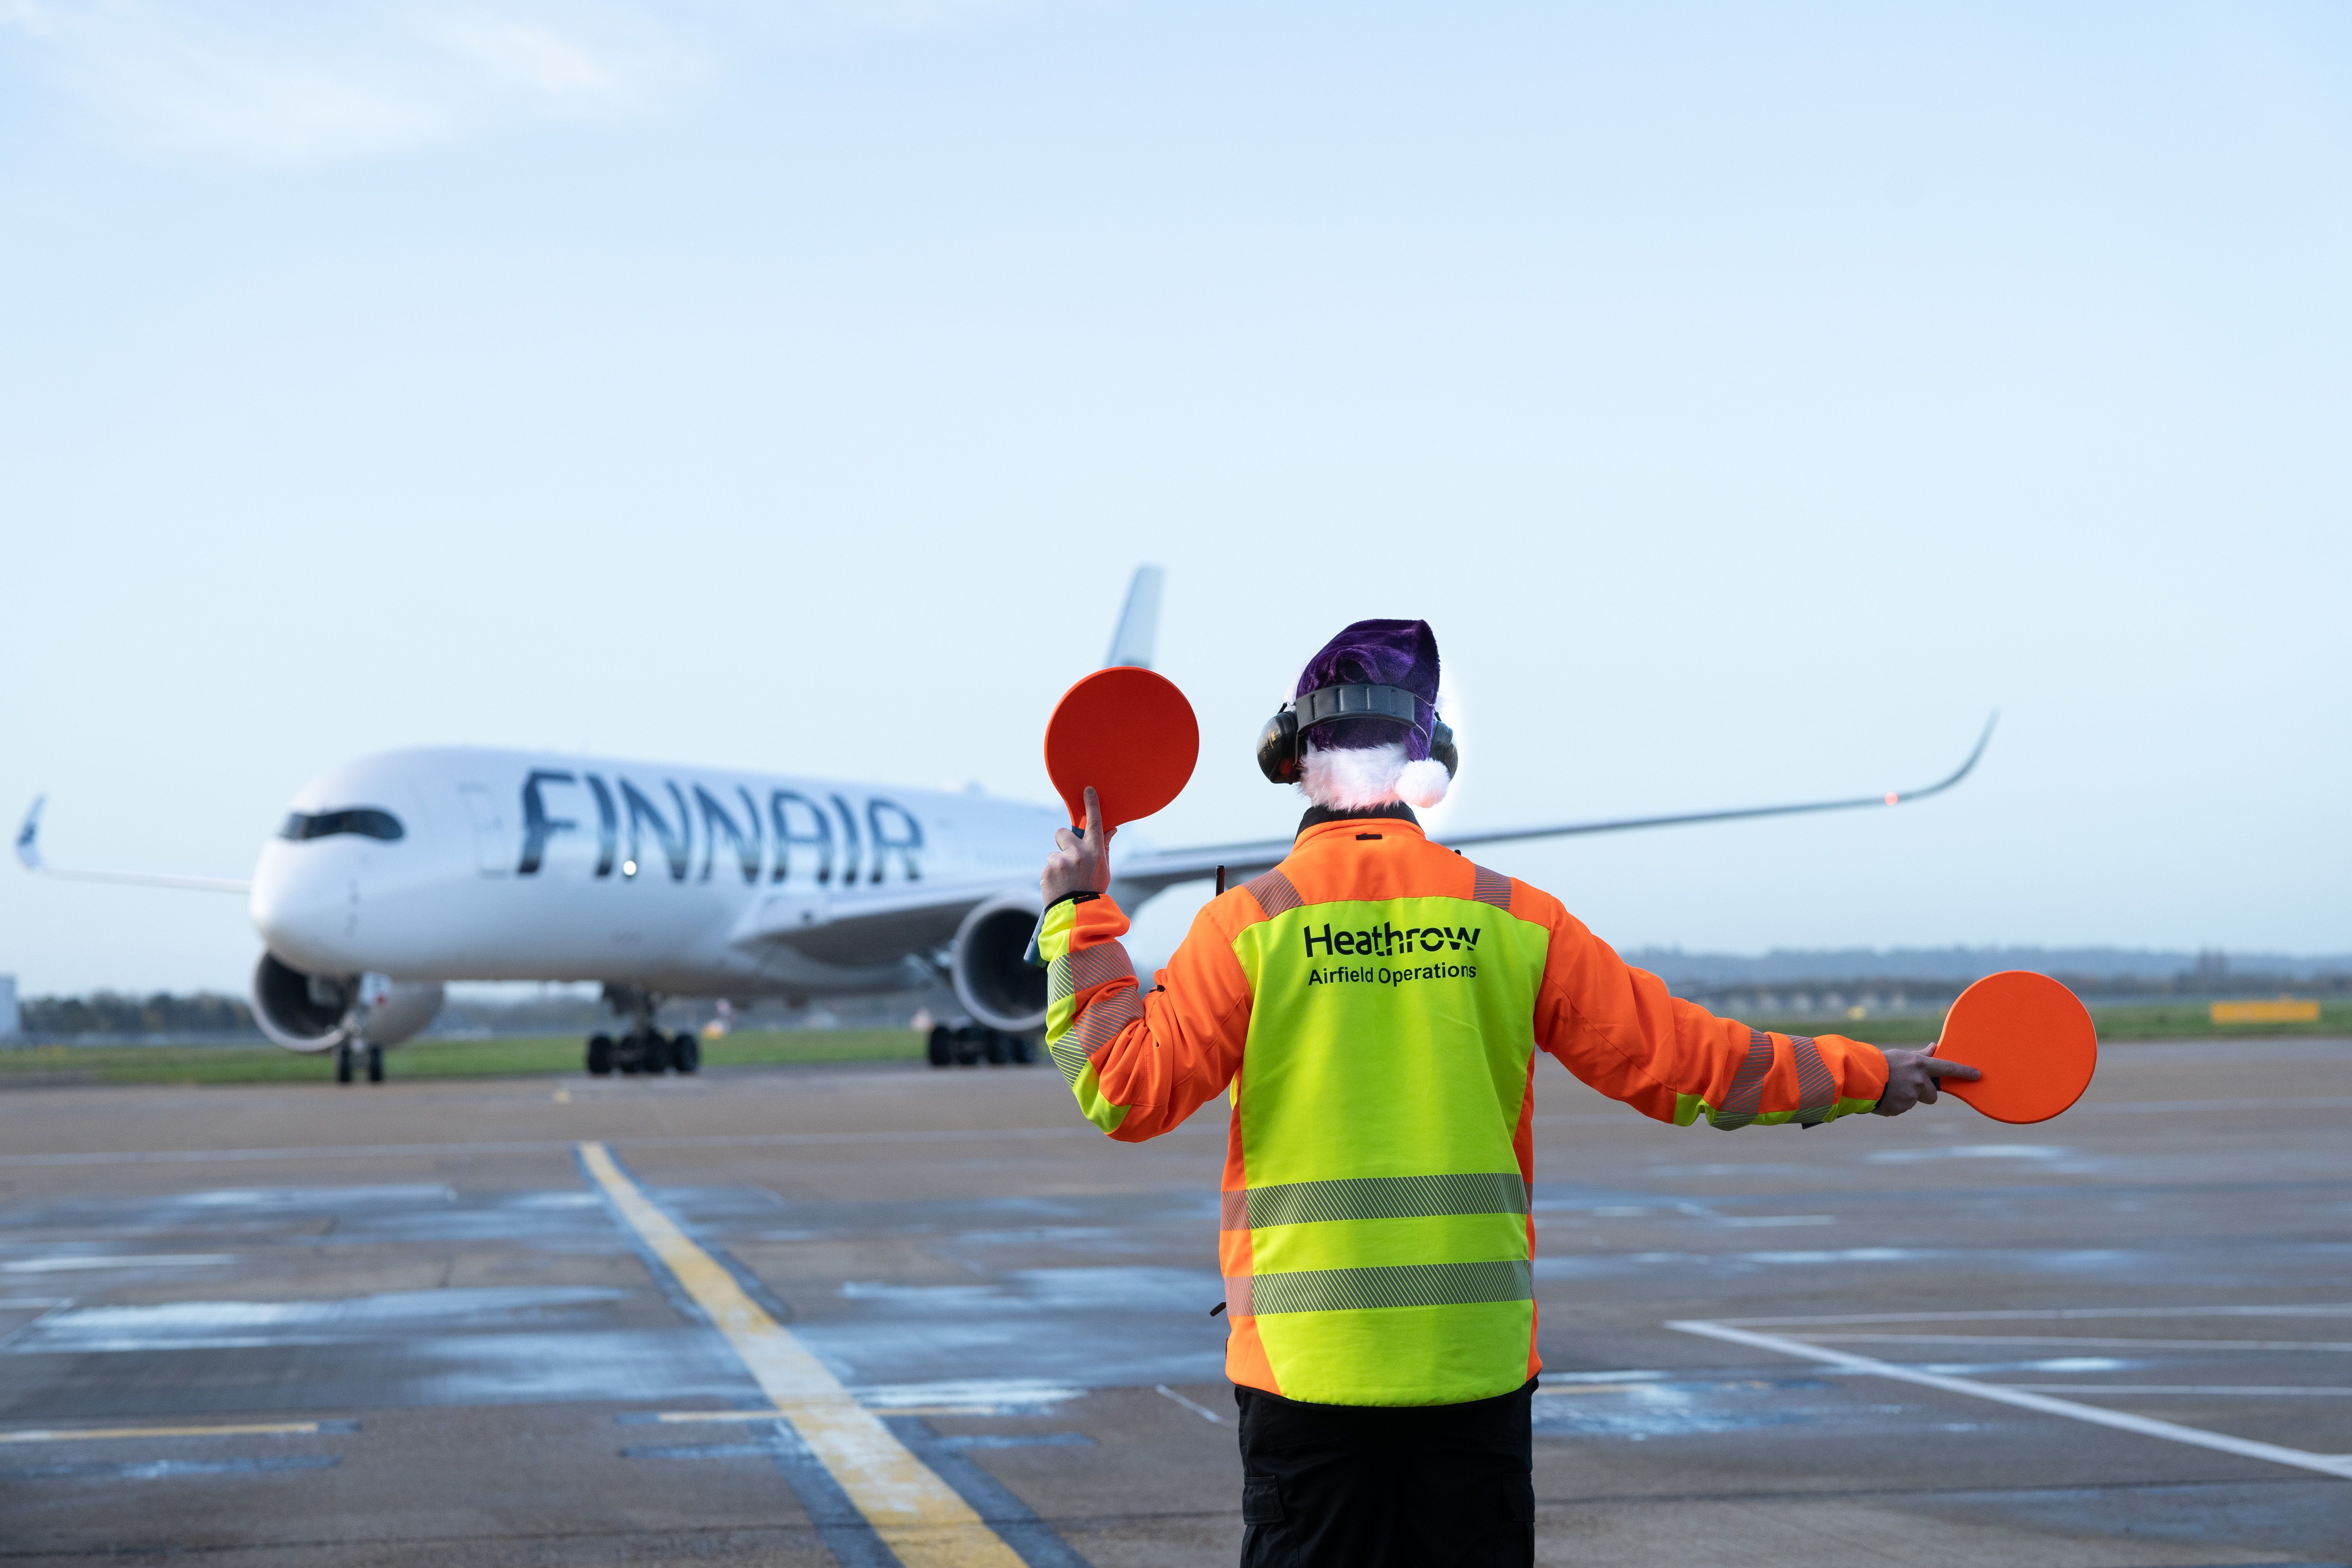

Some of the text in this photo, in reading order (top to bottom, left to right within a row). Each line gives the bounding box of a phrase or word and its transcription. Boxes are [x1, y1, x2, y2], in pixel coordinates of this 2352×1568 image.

[518, 769, 923, 884] FINNAIR
[1304, 921, 1481, 958] Heathrow
[1308, 962, 1477, 987] Airfield Operations
